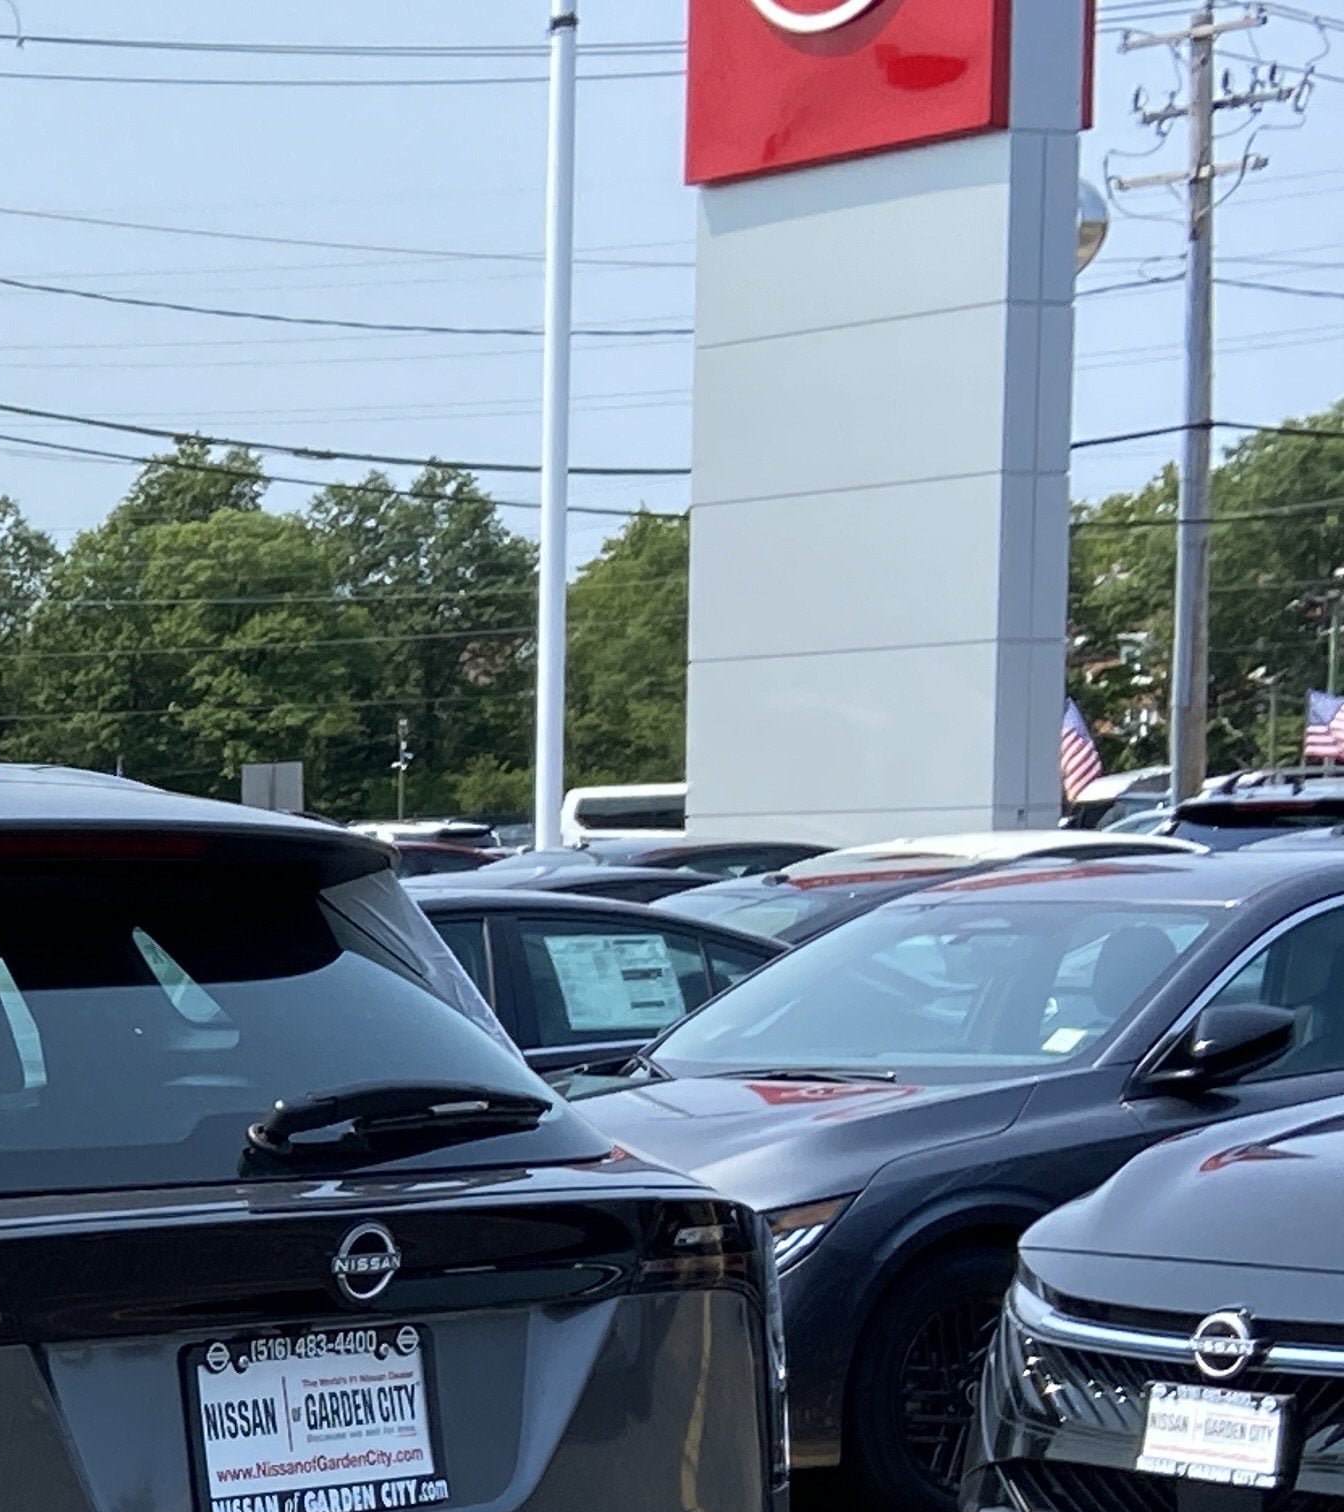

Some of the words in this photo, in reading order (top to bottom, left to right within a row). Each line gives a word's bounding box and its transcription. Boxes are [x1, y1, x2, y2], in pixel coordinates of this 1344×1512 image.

[334, 1255, 401, 1273] NISSAN
[251, 1338, 291, 1362] (516)
[295, 1330, 377, 1359] 483-4400
[204, 1397, 278, 1441] NISSAN
[304, 1387, 376, 1430] GARDEN
[376, 1383, 415, 1422] CITY
[216, 1447, 424, 1483] www.NissanofGardenCity.com
